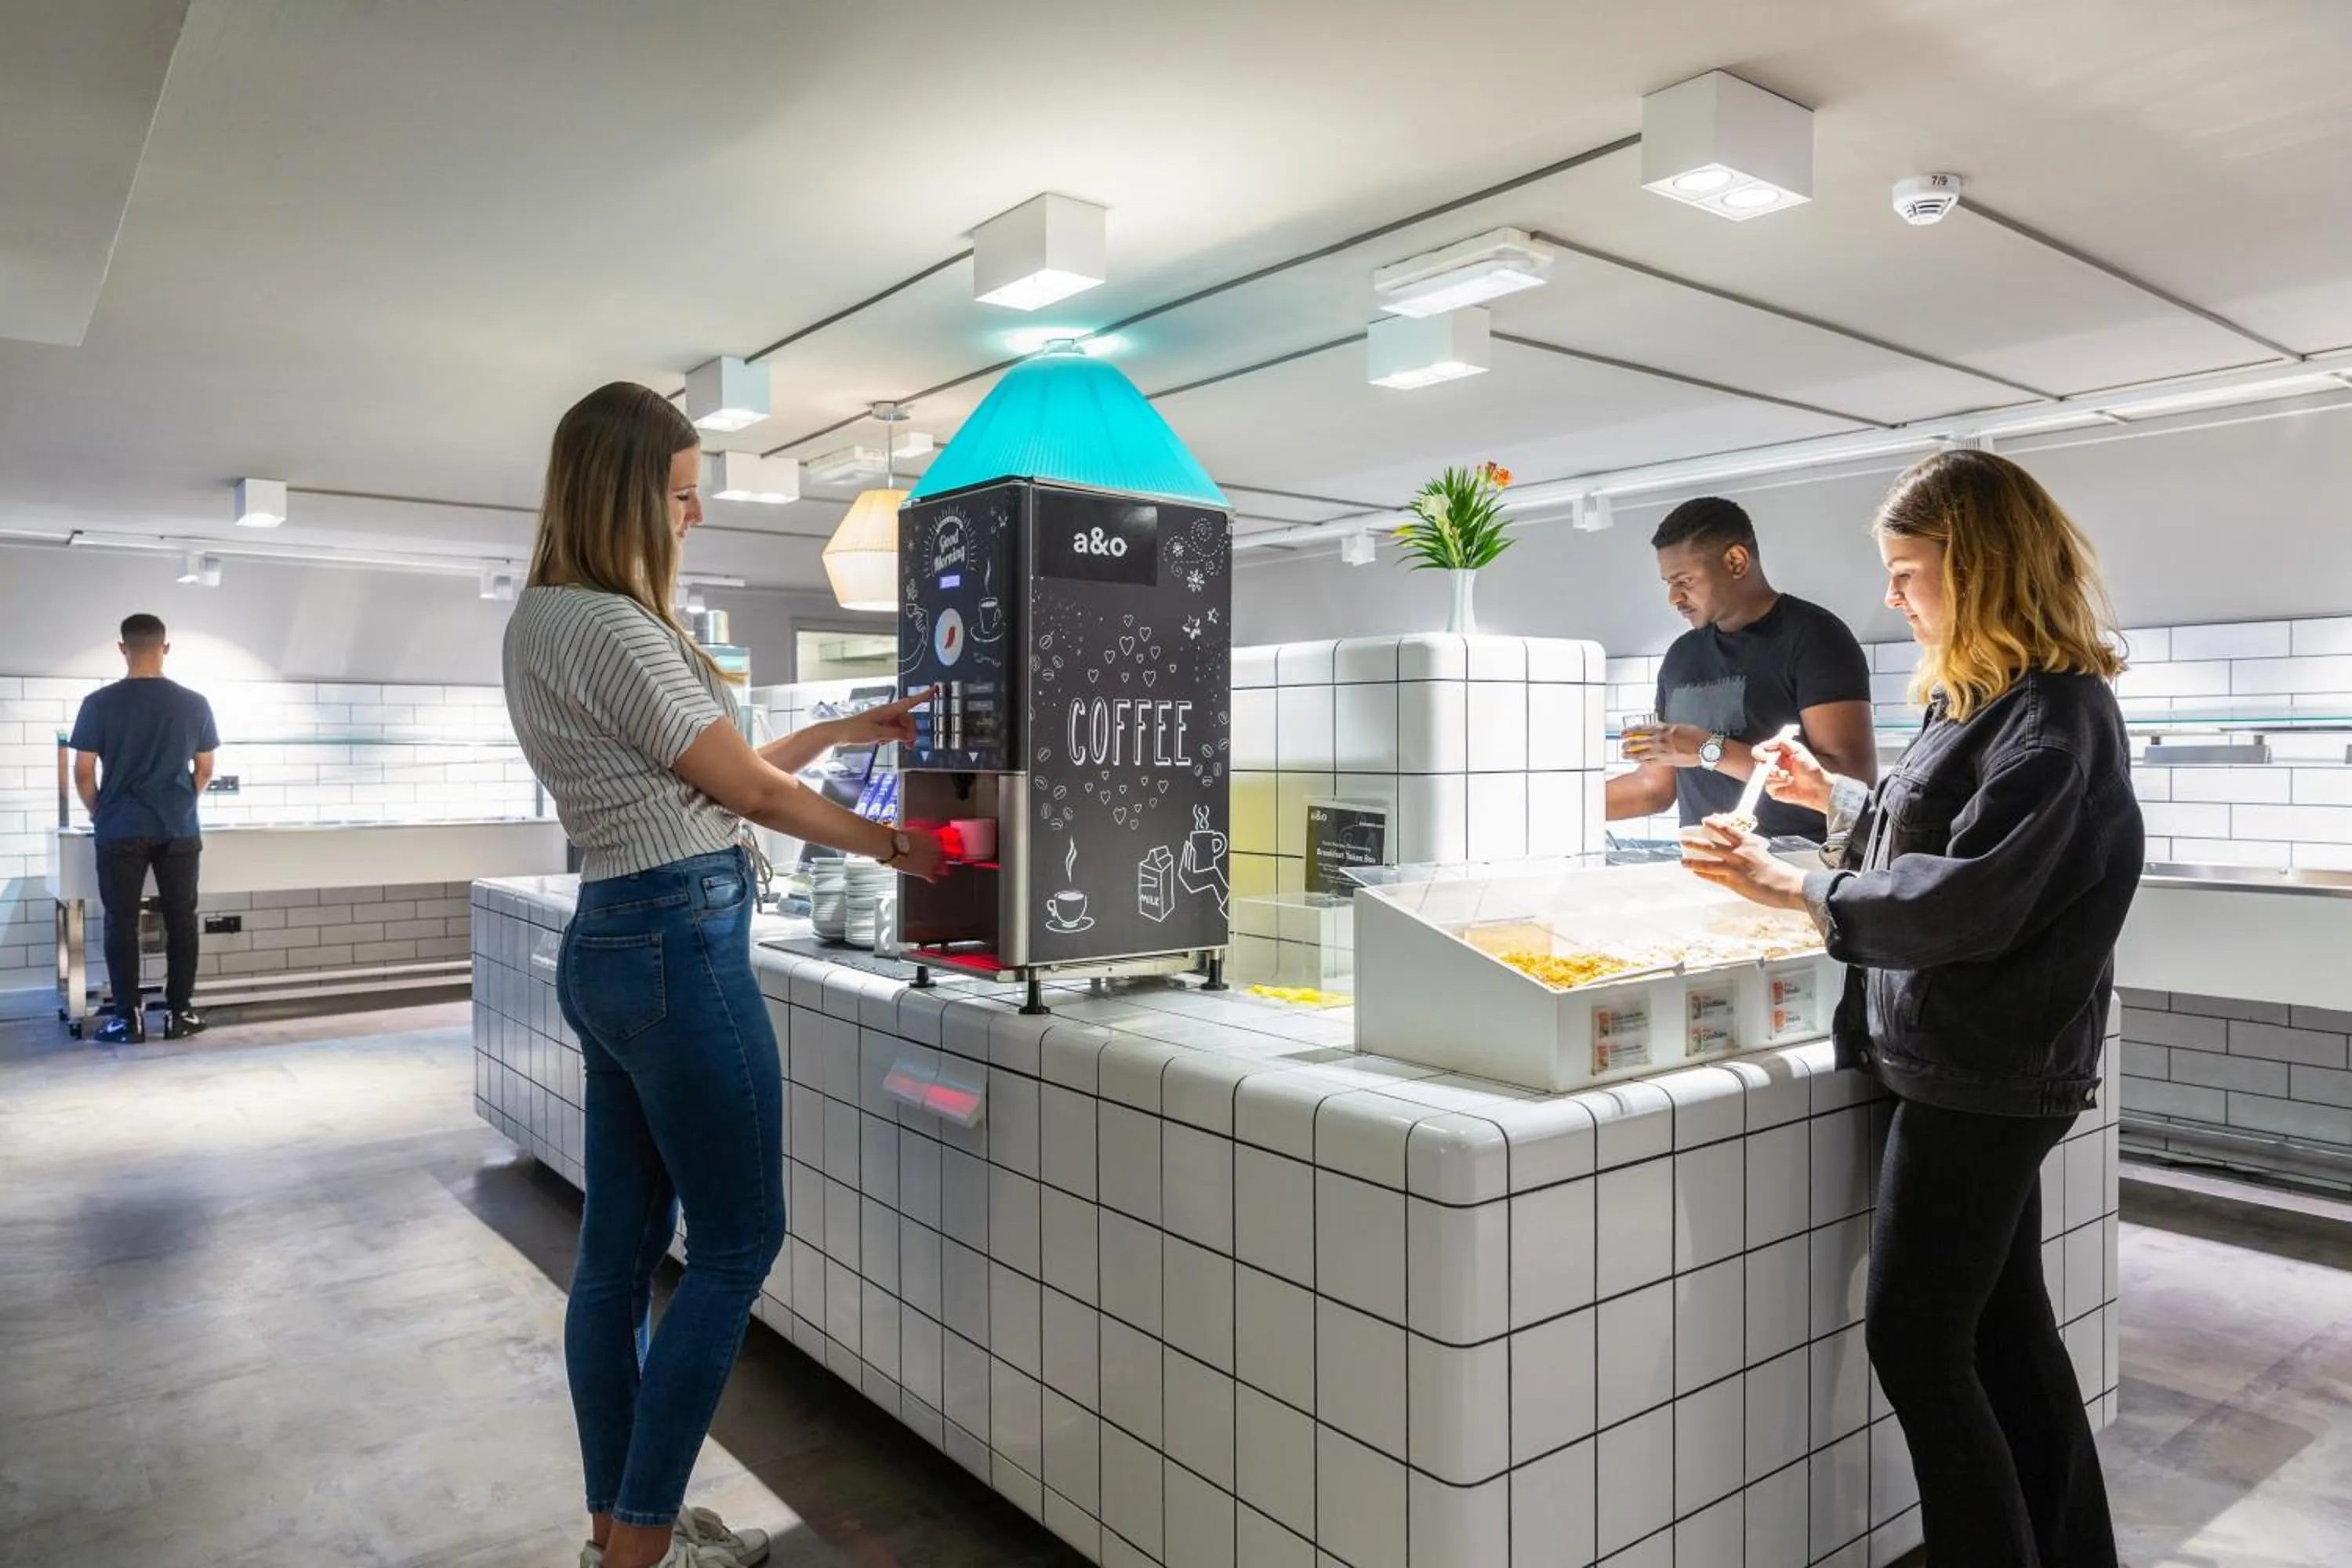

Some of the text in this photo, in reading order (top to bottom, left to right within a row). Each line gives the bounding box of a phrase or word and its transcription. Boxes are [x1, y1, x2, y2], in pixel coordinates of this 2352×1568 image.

[939, 528, 959, 554] Good
[1073, 526, 1128, 557] a&o
[934, 546, 965, 574] Morning
[1067, 696, 1192, 766] COFFEE
[1140, 894, 1160, 907] MILK
